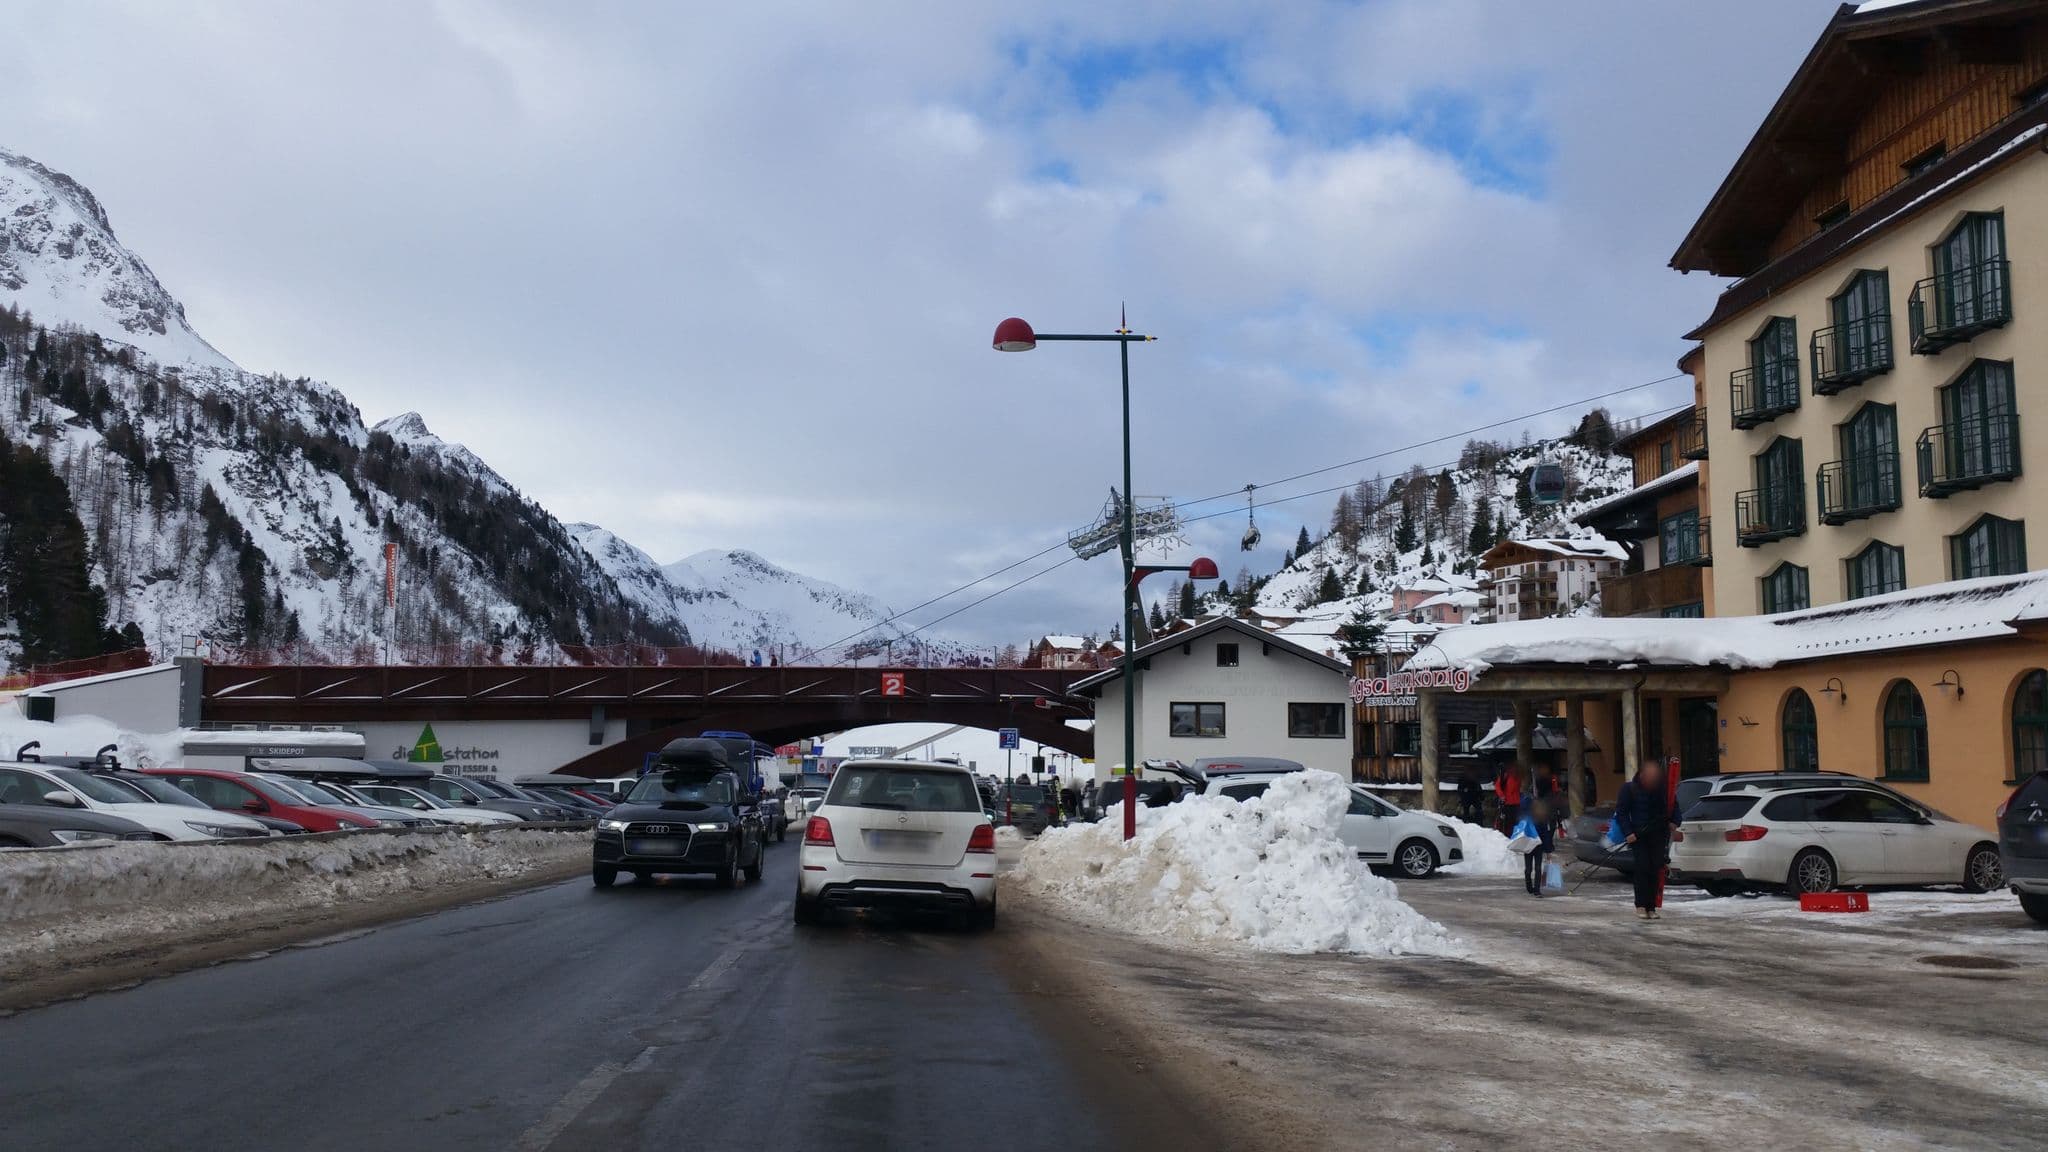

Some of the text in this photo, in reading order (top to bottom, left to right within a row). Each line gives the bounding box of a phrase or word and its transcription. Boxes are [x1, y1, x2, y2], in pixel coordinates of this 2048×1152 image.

[886, 678, 900, 696] 2
[1365, 697, 1417, 706] RESTAURANT
[268, 747, 305, 755] SKIDEPOT
[462, 764, 498, 773] ESSEN &
